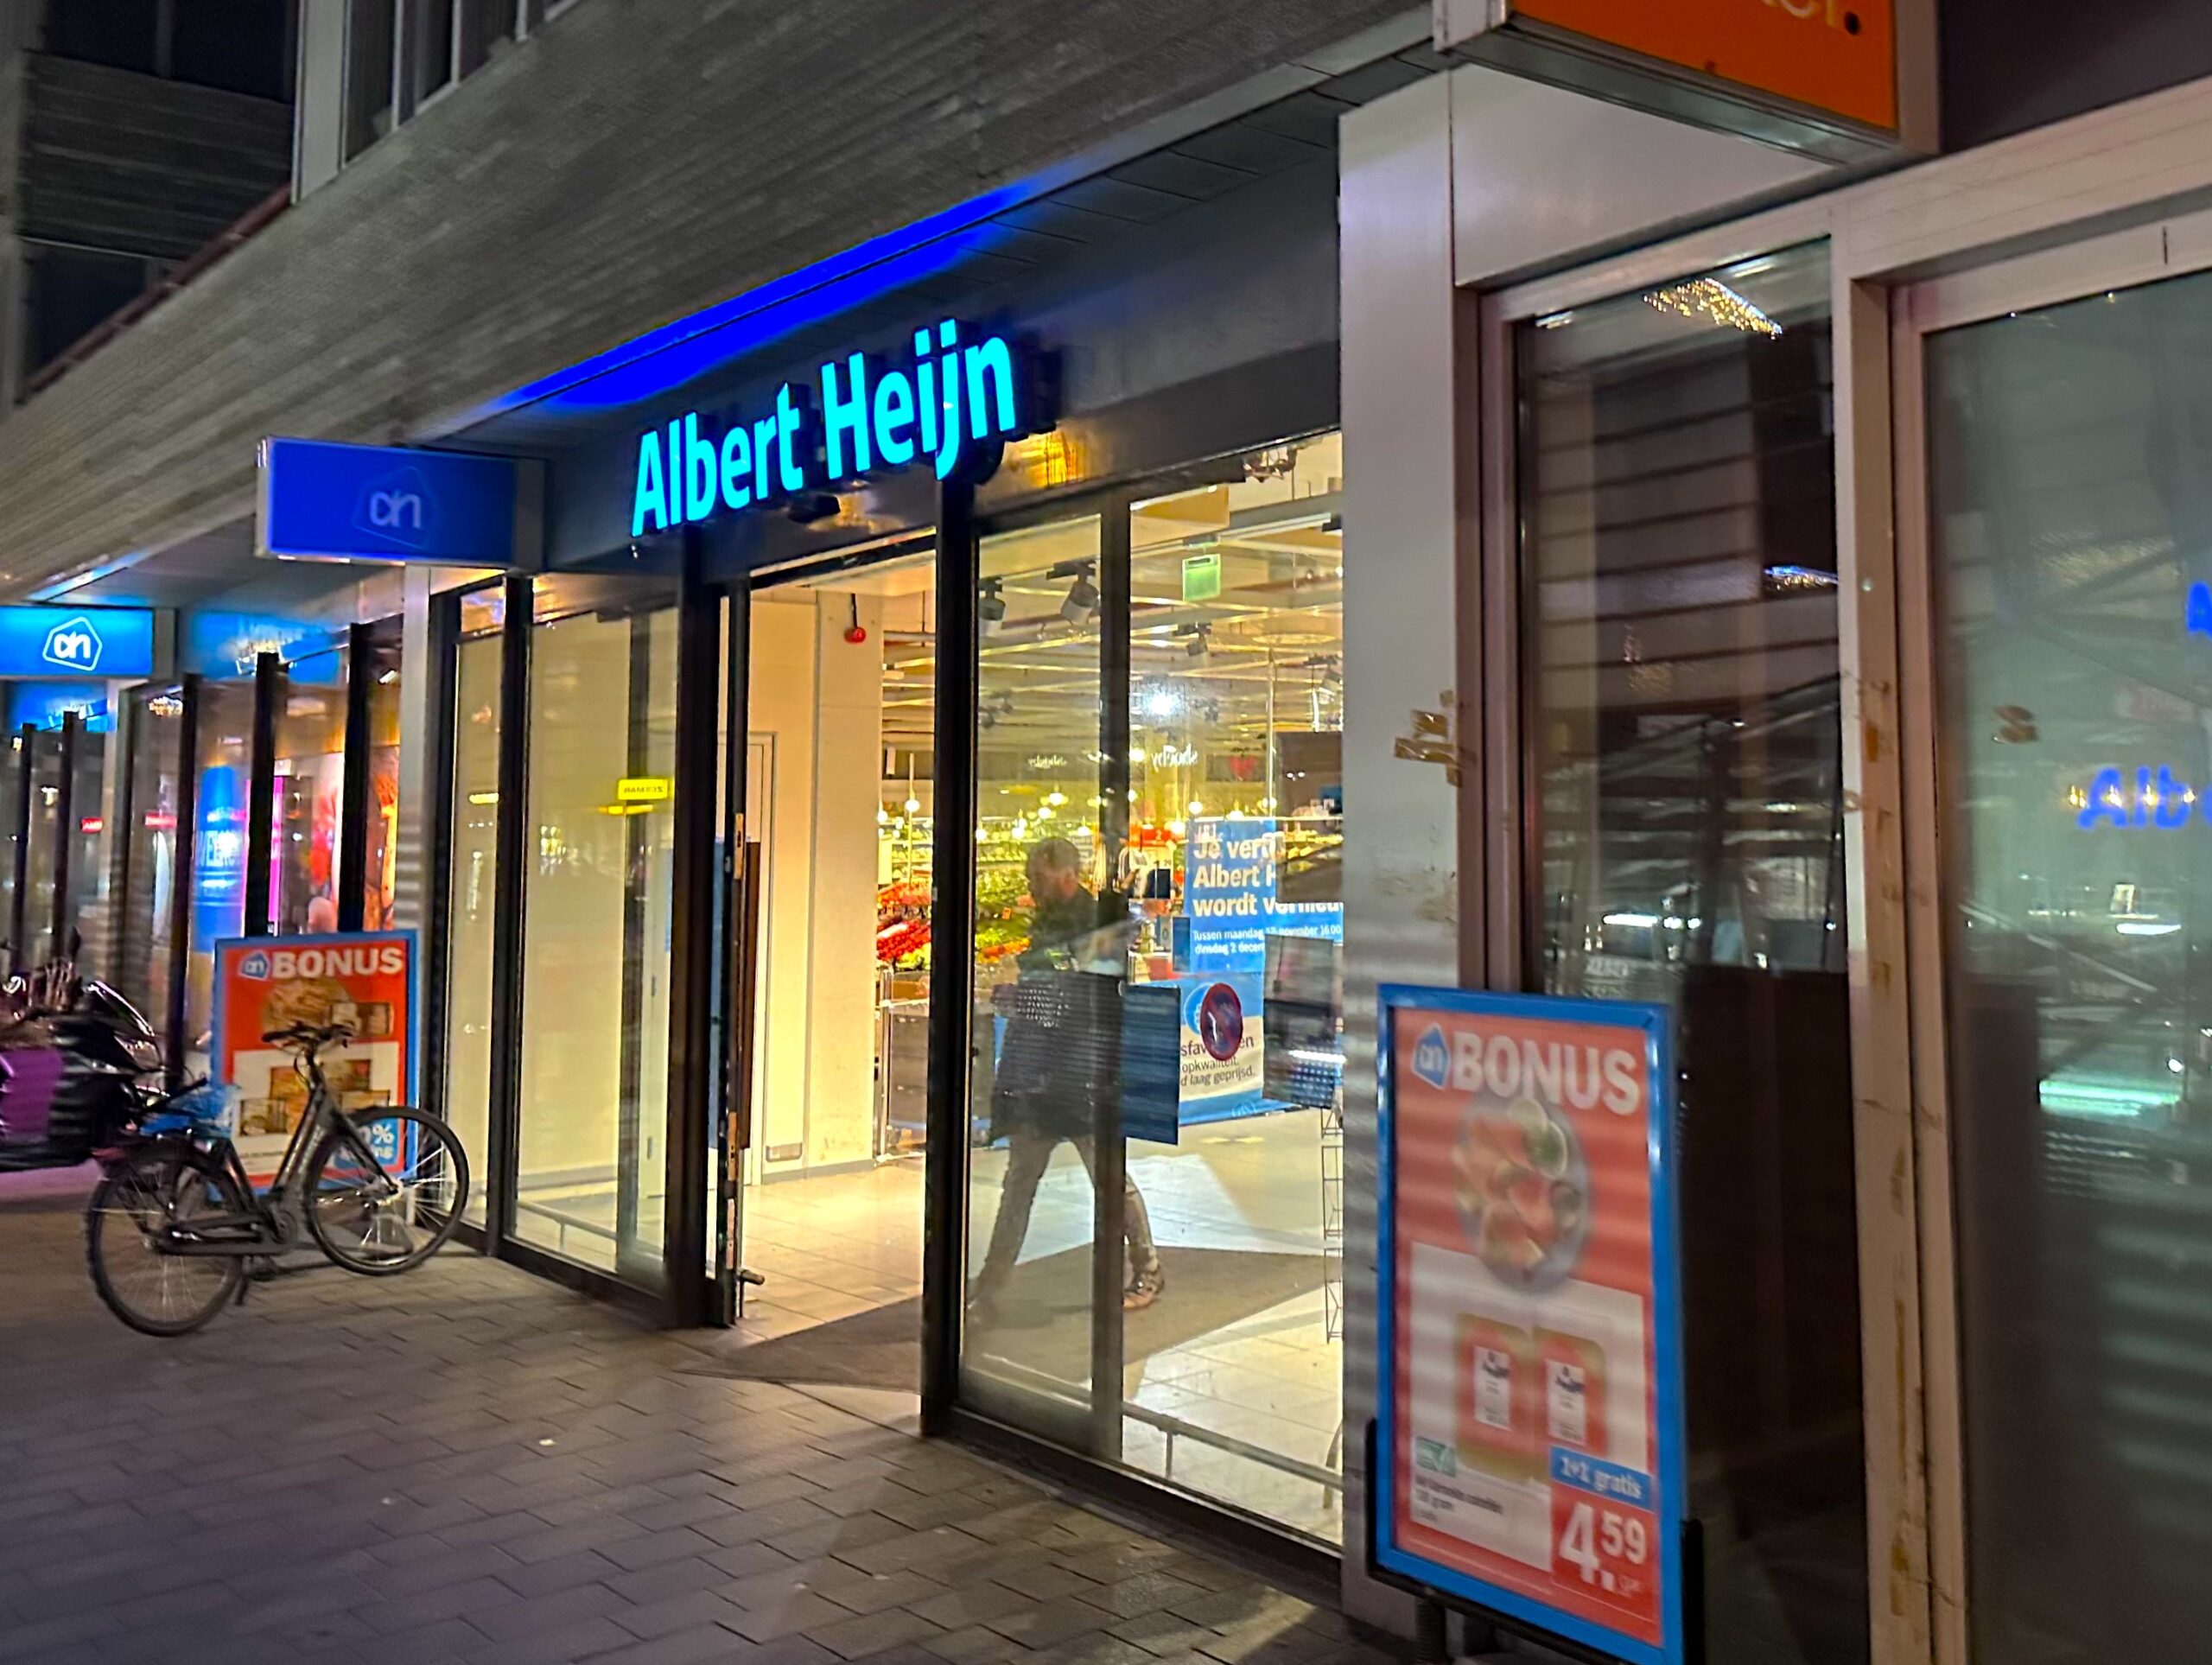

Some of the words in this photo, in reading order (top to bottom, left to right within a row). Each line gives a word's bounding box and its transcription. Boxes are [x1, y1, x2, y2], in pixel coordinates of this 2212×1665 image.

[631, 382, 804, 538] Albert
[819, 318, 1017, 480] Heijn
[2077, 764, 2212, 830] Alb
[1193, 837, 1221, 860] Je
[1193, 864, 1261, 888] Albert
[1193, 892, 1258, 917] wordt
[1193, 929, 1223, 941] Tussen
[1224, 926, 1264, 940] maandag
[272, 947, 404, 980] BONUS
[1190, 1073, 1211, 1086] laag
[1452, 1030, 1641, 1116] BONUS
[1593, 1469, 1643, 1500] gratis
